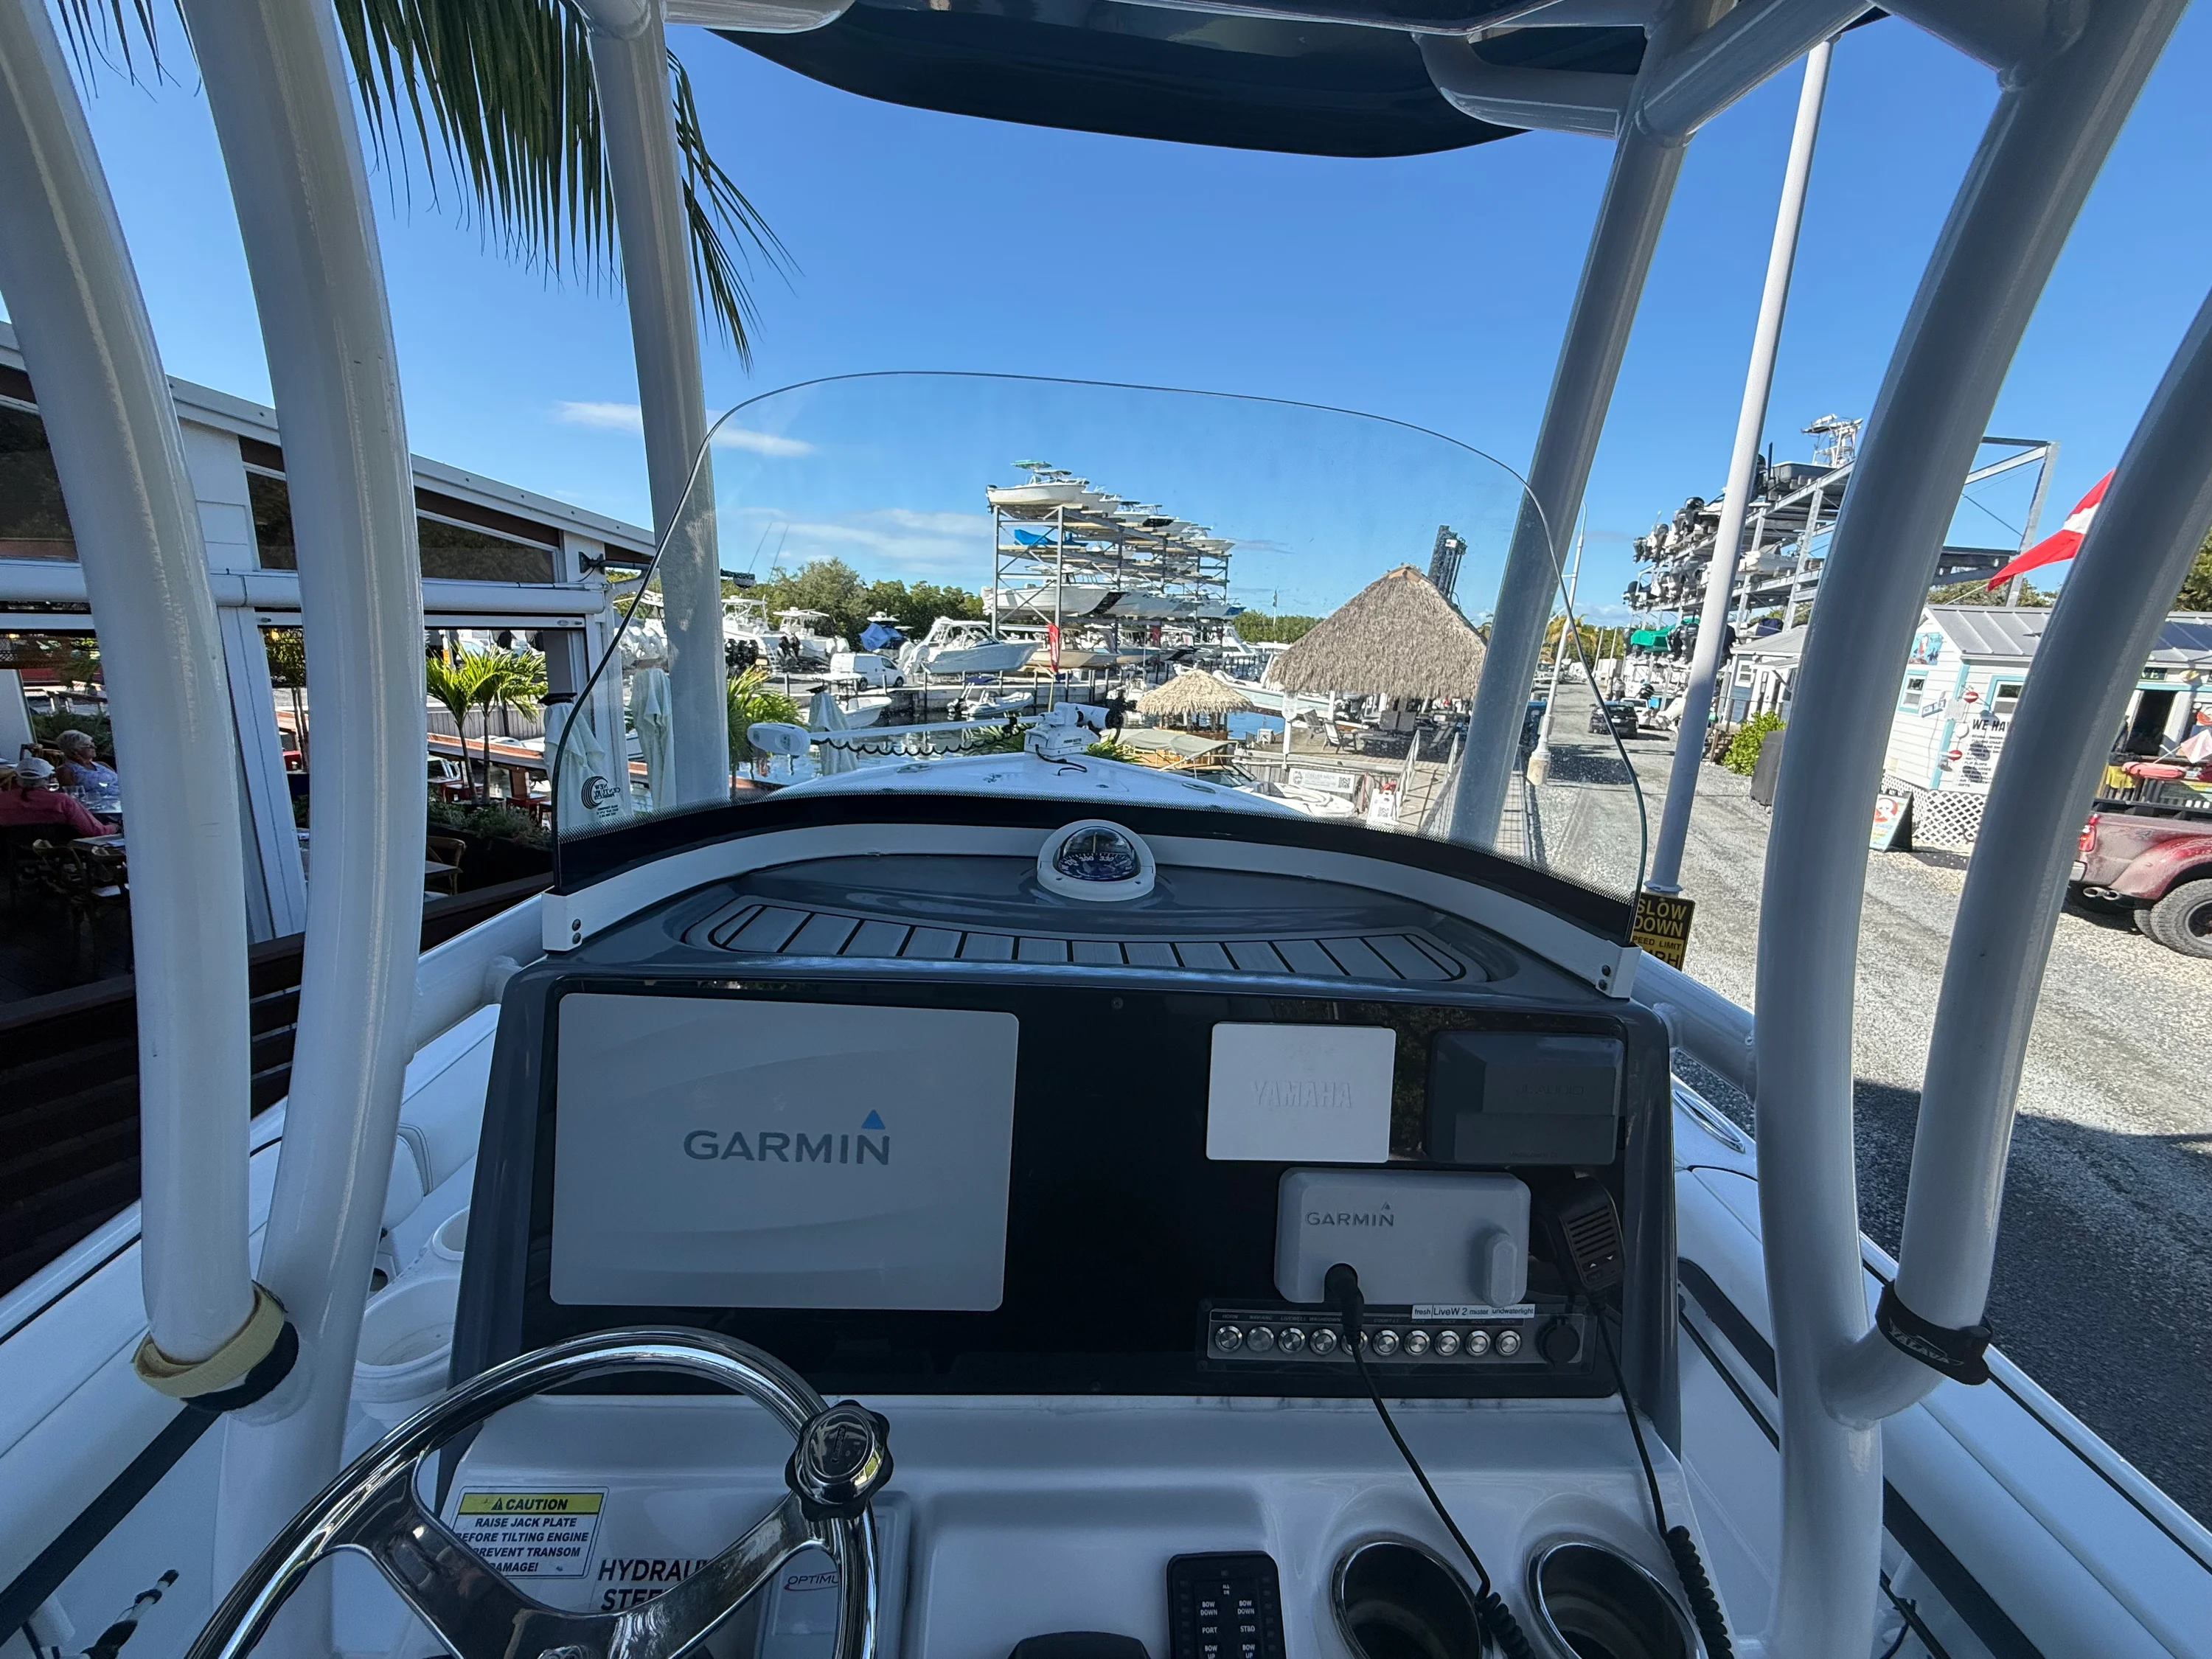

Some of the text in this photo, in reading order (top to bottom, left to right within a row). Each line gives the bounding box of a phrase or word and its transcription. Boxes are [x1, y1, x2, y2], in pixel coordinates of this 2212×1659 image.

[1972, 719, 1989, 730] WE
[1637, 899, 1687, 920] SLOW
[1634, 914, 1683, 937] DOWN
[1632, 936, 1682, 951] PEED LIMIT
[1649, 949, 1680, 970] PH
[1251, 1080, 1352, 1107] YAMAHA
[684, 1130, 890, 1166] GARMIN
[1305, 1211, 1394, 1227] GARMIN
[1414, 1307, 1534, 1316] fresh LiveW 2 mister undwaterlight
[505, 1498, 568, 1511] CAUTION
[475, 1517, 577, 1528] RAISE JACK PLATE
[501, 1532, 545, 1543] TILTING
[547, 1531, 589, 1542] ENGINE
[527, 1547, 581, 1557] TRANSOM
[598, 1559, 707, 1582] HYDRAU
[787, 1574, 839, 1586] OPTIMU
